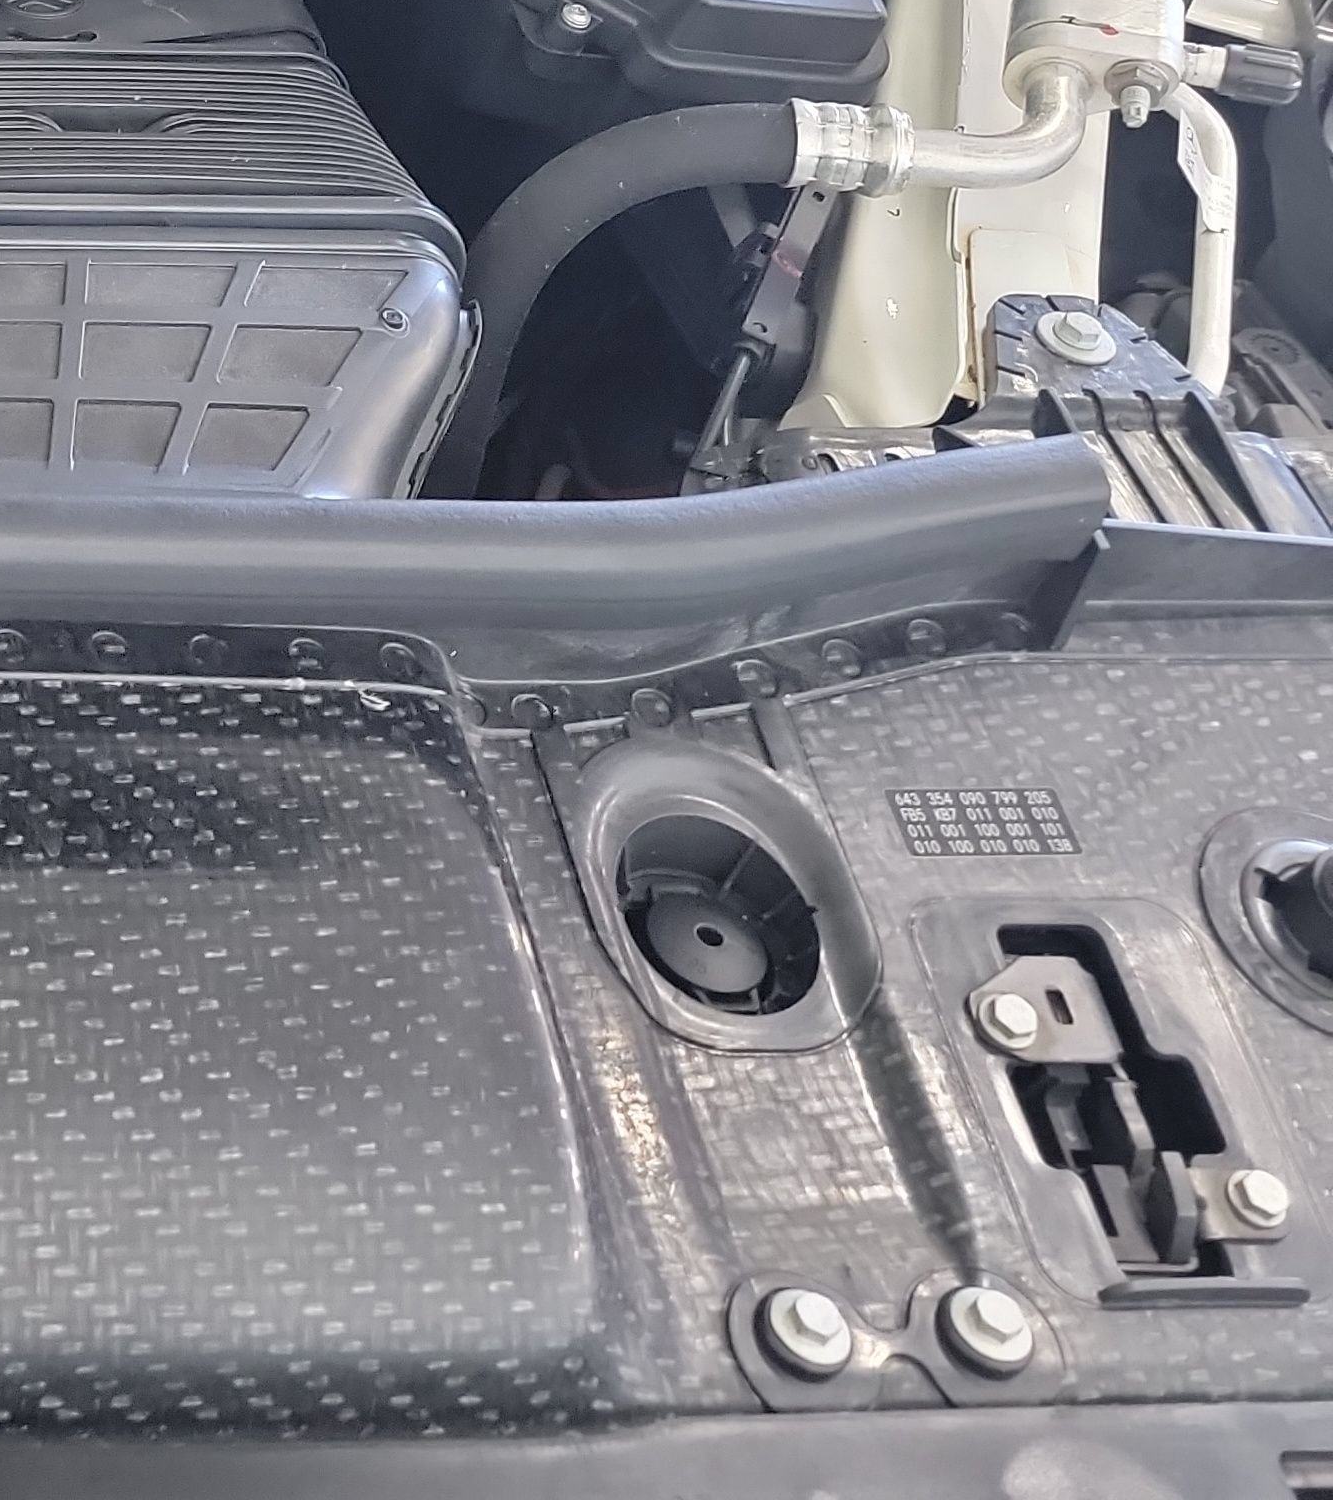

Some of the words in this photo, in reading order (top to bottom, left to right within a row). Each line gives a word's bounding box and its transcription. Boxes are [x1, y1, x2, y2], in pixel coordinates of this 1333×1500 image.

[894, 793, 921, 806] 643
[925, 792, 953, 806] 354
[958, 792, 986, 805] 090
[990, 791, 1018, 805] 799
[1023, 791, 1052, 804] 205
[965, 807, 992, 821] 011
[998, 807, 1025, 821] 001
[1031, 807, 1059, 820] 010
[907, 824, 933, 838] 011
[939, 824, 966, 838] 001
[973, 823, 1000, 837] 100
[1005, 823, 1032, 837] 001
[1039, 823, 1065, 836] 101
[914, 840, 941, 854] 010
[948, 840, 975, 854] 100
[980, 840, 1007, 854] 010
[1012, 840, 1040, 853] 010
